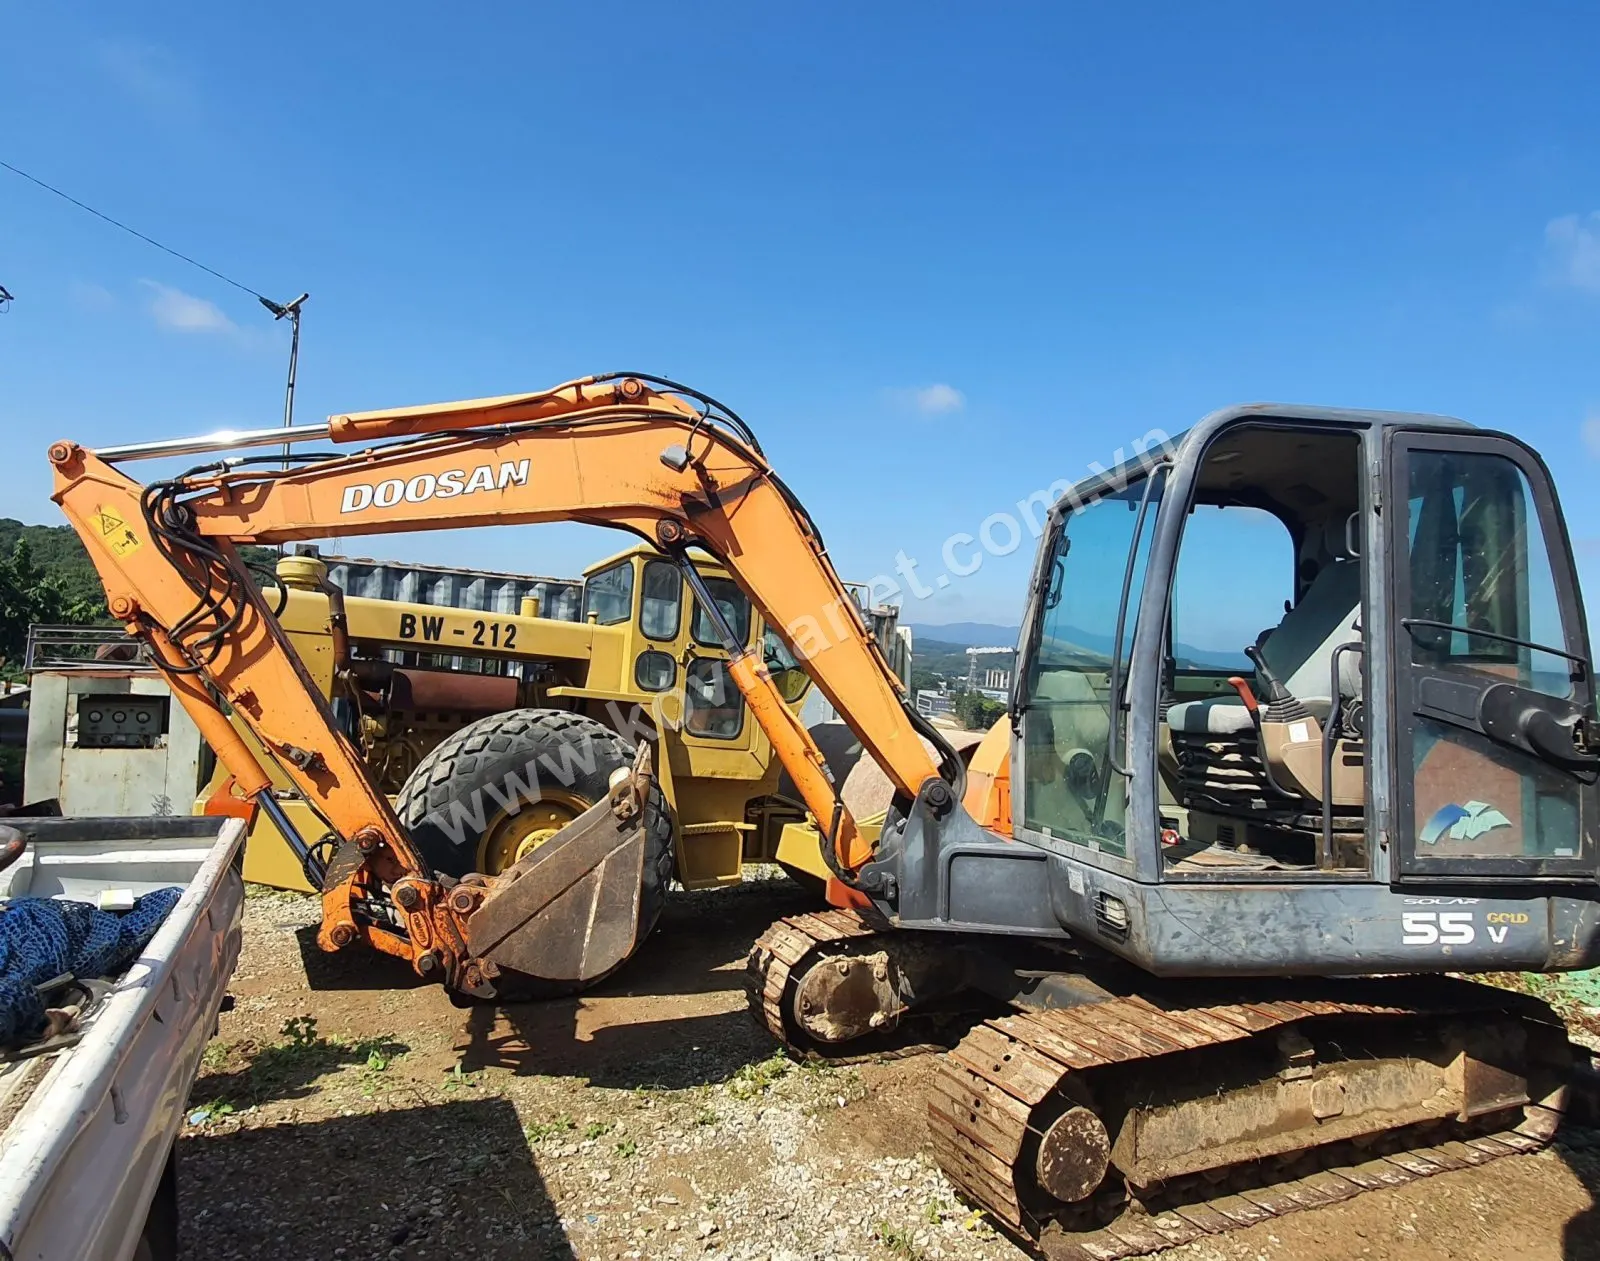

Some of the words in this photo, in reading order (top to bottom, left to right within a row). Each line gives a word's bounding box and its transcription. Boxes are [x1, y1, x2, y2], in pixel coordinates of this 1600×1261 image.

[340, 459, 531, 513] DOOSAN
[1402, 912, 1475, 944] 55
[1486, 926, 1508, 944] V
[1486, 912, 1529, 924] GOLD
